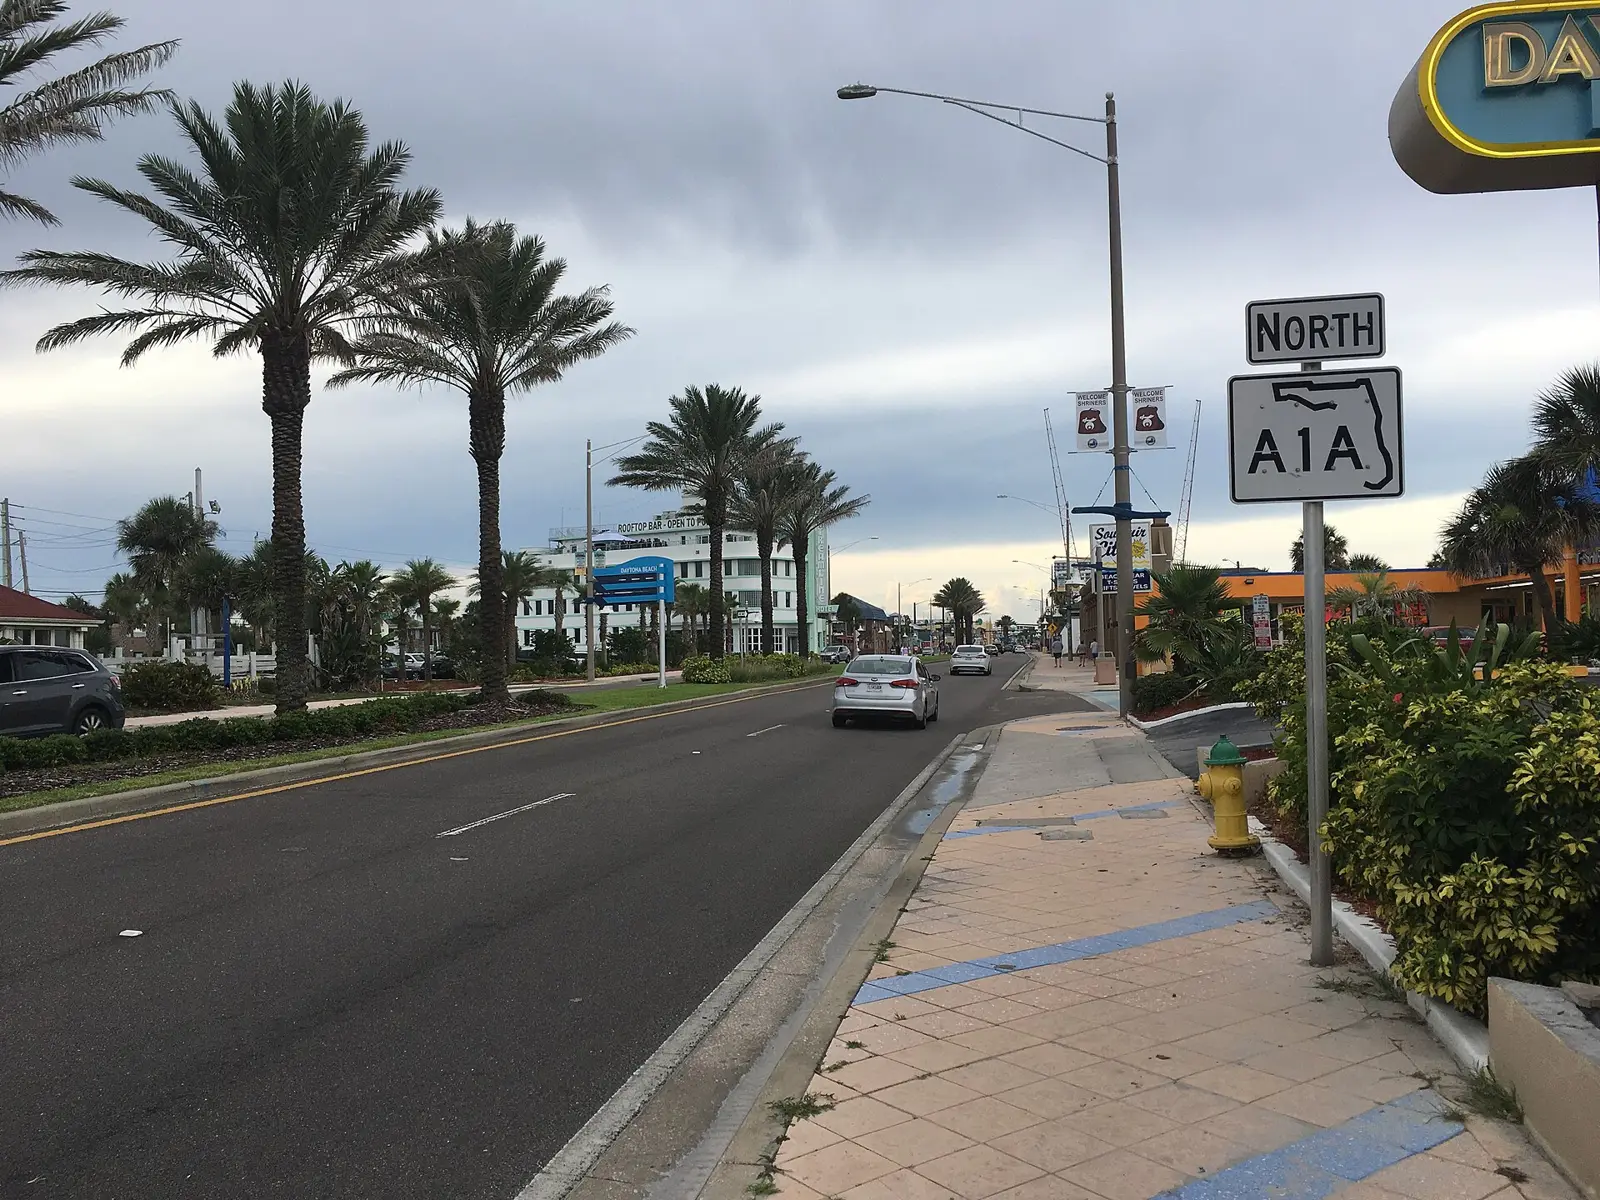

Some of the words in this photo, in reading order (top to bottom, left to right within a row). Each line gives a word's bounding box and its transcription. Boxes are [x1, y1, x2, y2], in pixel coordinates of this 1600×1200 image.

[1256, 311, 1374, 352] NORTH
[1133, 390, 1164, 398] WELCOME
[1248, 425, 1363, 474] A1A
[617, 523, 647, 533] ROOFTOP
[648, 521, 662, 530] BAR
[667, 519, 685, 528] OPEN
[686, 518, 695, 527] TO
[1095, 526, 1147, 540] Sounir
[620, 566, 641, 574] DAYTONA
